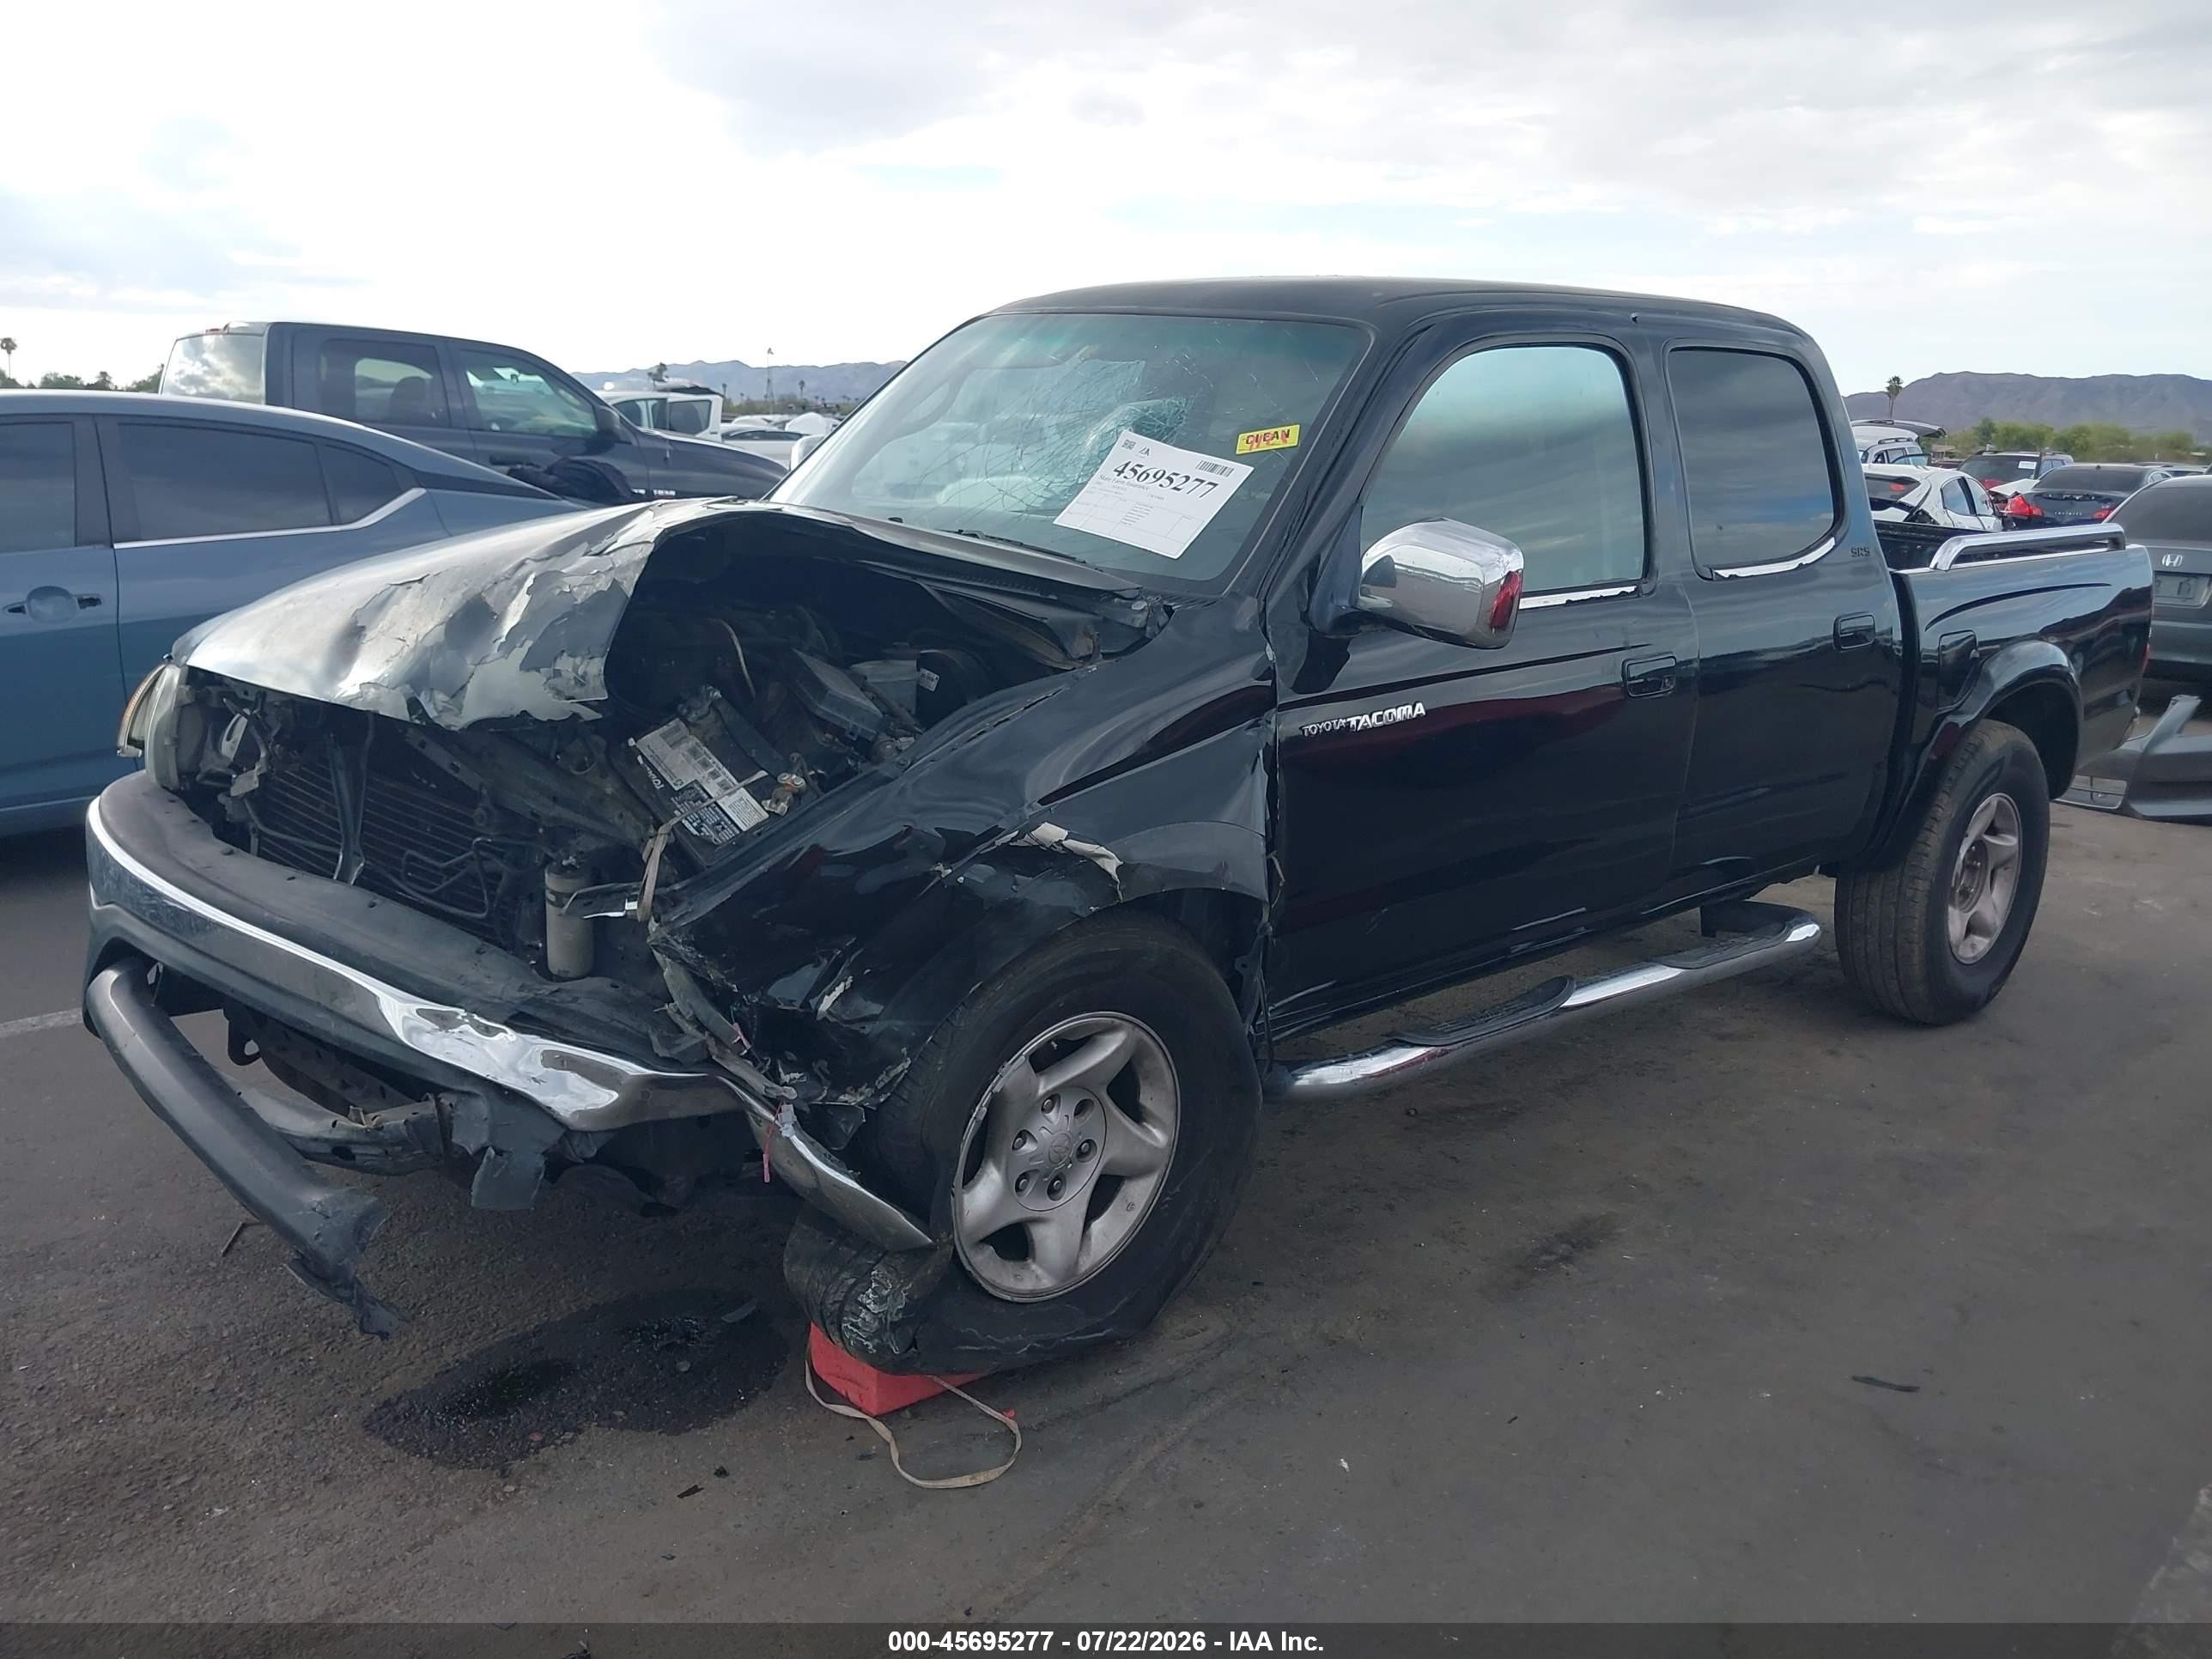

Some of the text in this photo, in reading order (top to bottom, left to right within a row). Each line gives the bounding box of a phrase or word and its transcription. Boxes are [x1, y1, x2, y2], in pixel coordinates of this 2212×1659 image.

[1113, 460, 1219, 499] 45695277
[1302, 702, 1426, 737] TOYOTA TACOMA
